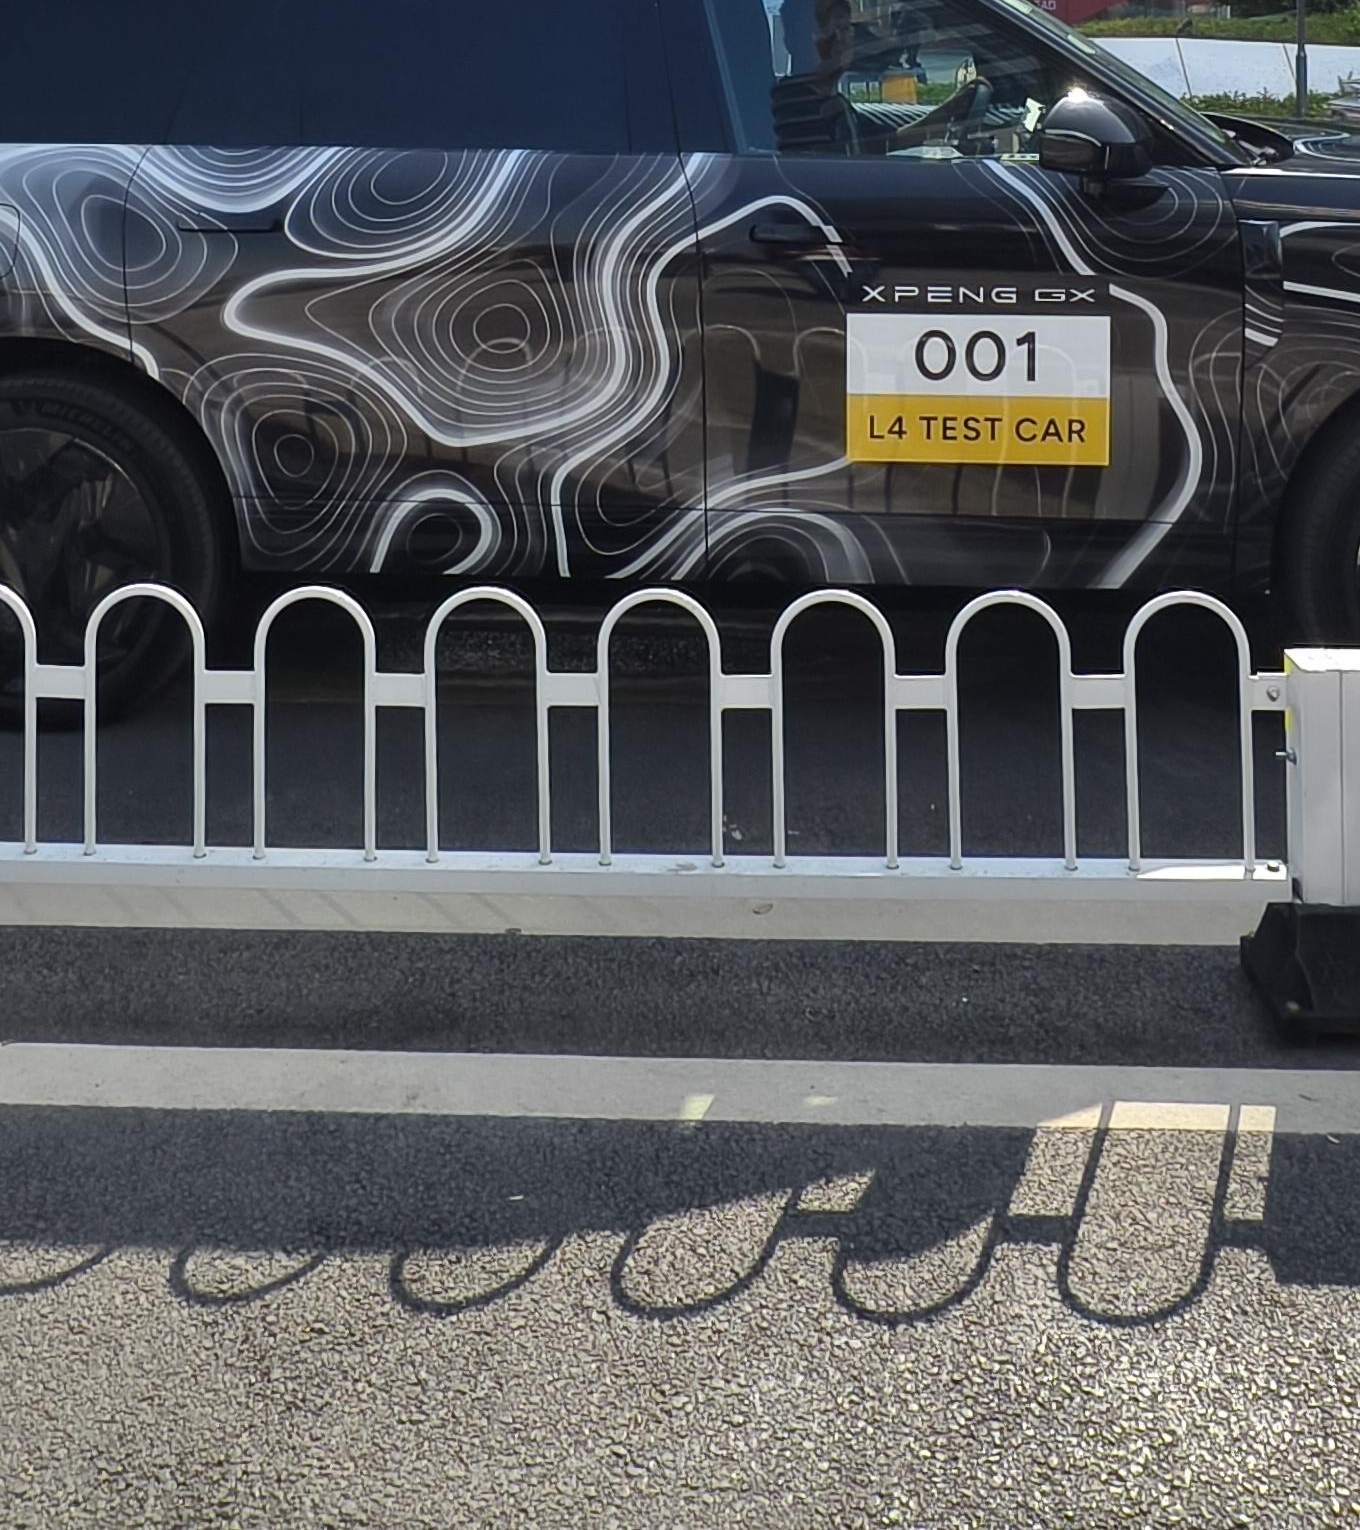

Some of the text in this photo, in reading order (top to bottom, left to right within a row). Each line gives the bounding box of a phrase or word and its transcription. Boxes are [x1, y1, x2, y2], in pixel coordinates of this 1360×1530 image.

[861, 285, 1096, 304] XPENG GX
[914, 329, 1039, 382] 001
[868, 415, 1087, 444] L4 TEST CAR
